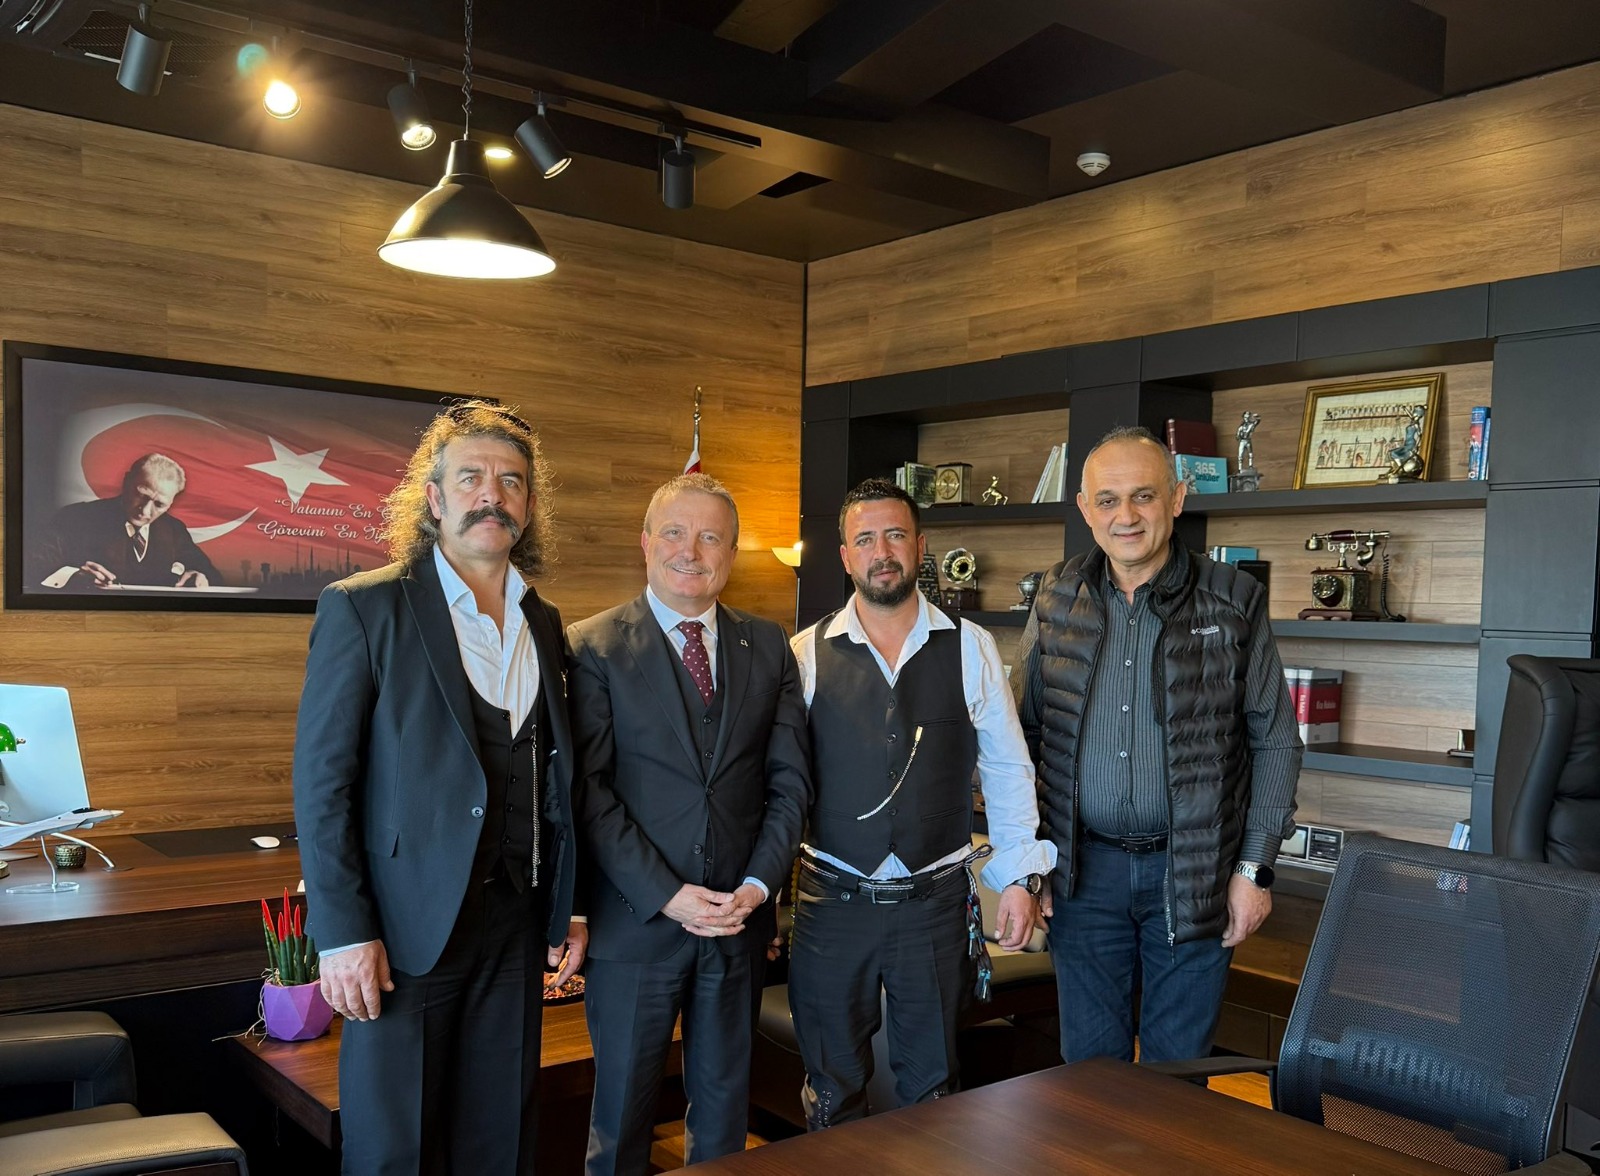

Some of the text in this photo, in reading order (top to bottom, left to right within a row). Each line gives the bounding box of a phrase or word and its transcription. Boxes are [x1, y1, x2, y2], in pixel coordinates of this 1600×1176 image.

[1195, 461, 1216, 476] 365
[349, 504, 374, 519] En
[257, 520, 391, 544] Görevini En İy
